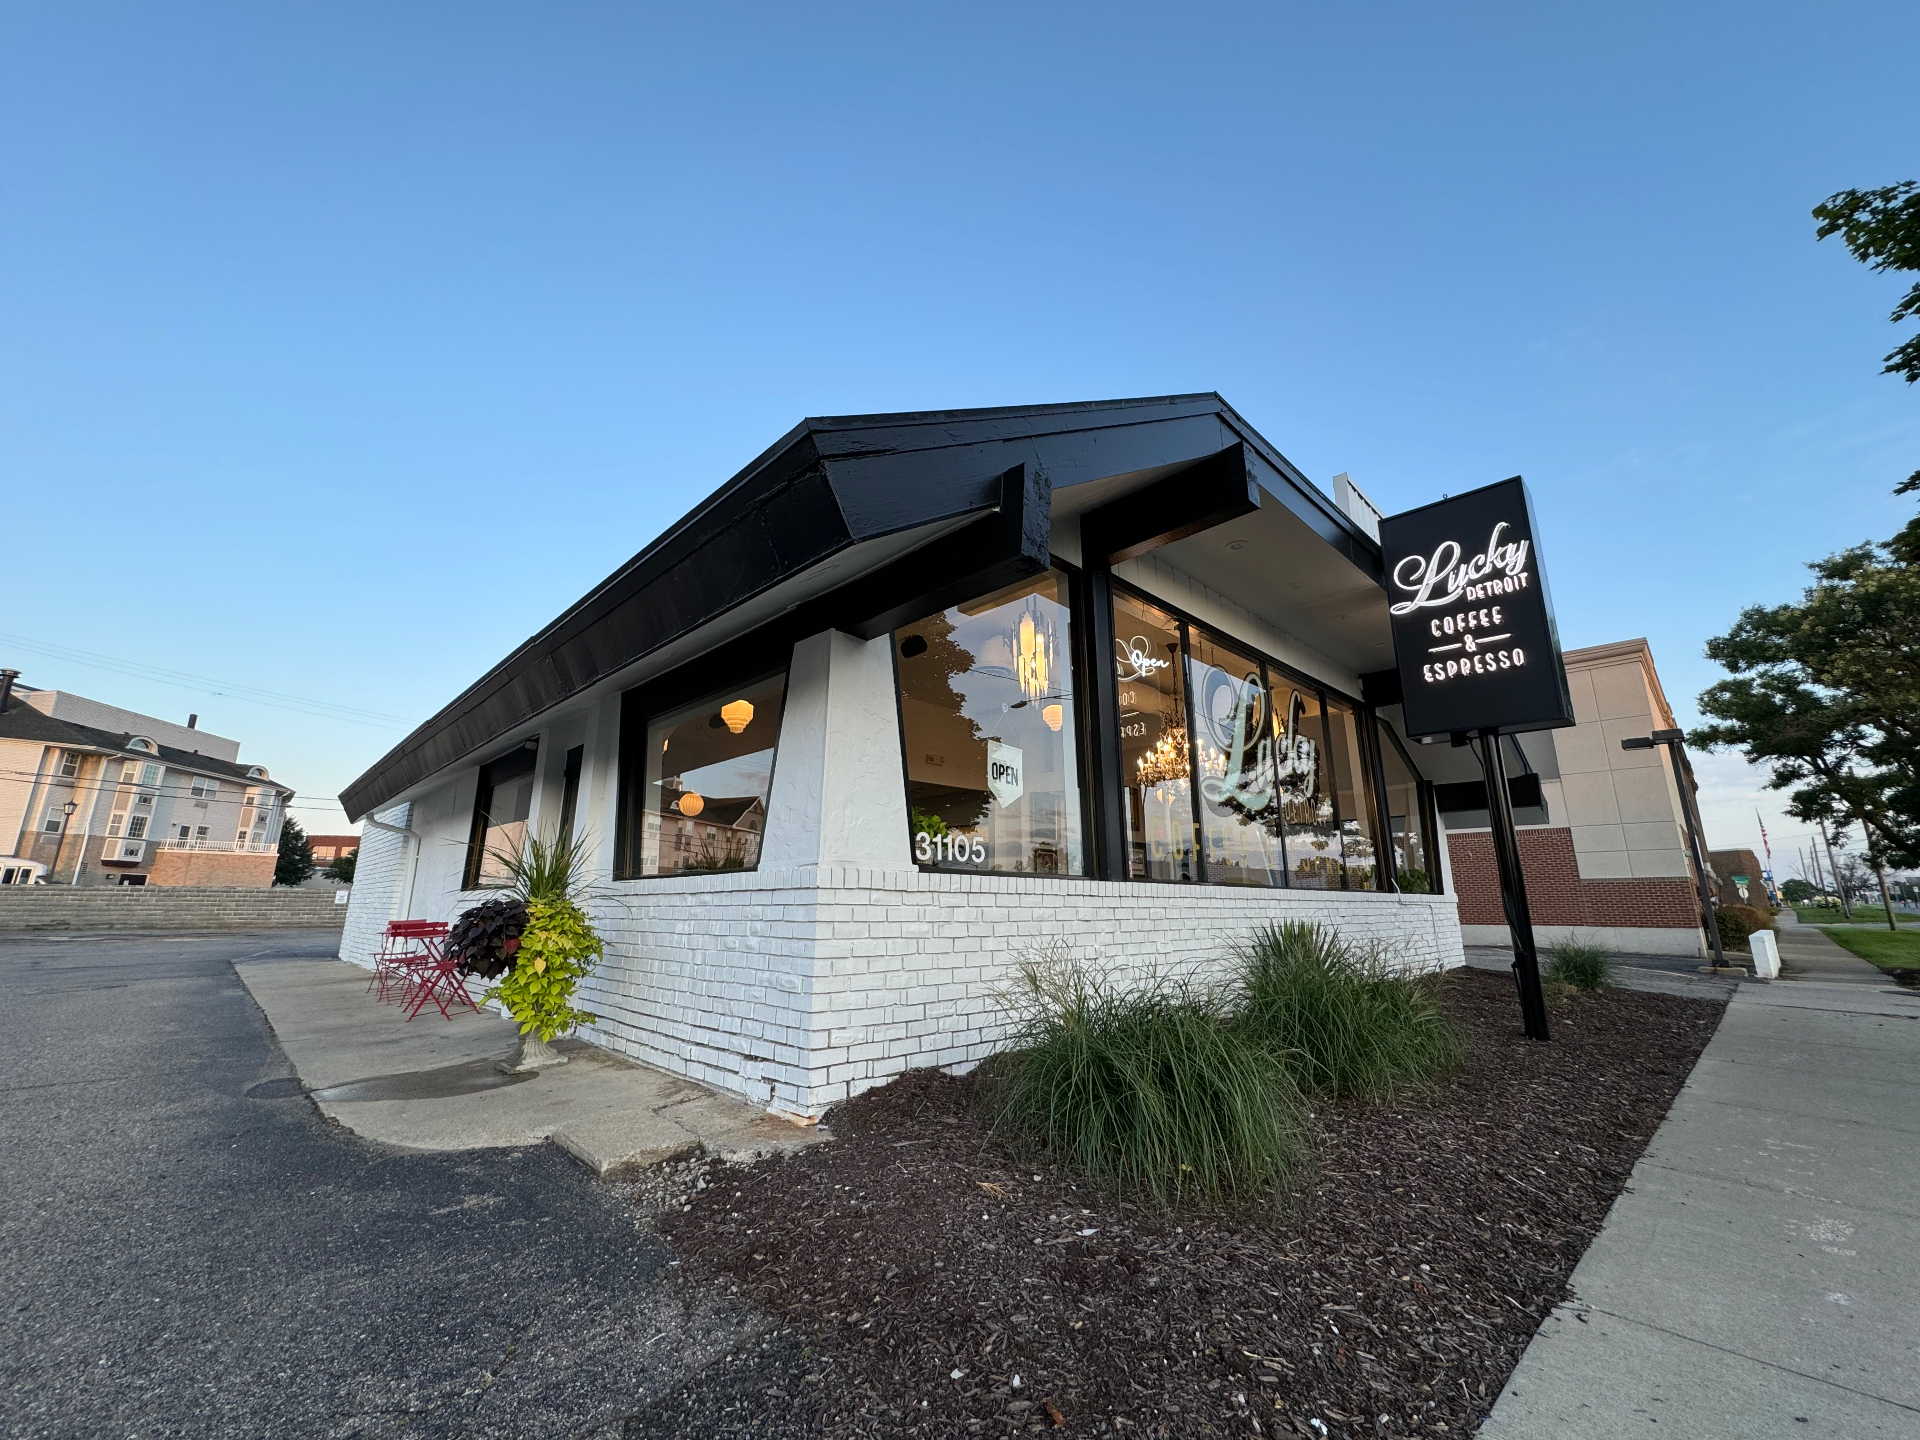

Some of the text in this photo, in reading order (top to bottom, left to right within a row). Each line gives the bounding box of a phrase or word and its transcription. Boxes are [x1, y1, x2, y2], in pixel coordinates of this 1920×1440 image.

[1390, 522, 1530, 615] Lucky
[1467, 572, 1529, 602] DETROIT
[1431, 606, 1503, 637] COFFEE
[1463, 634, 1477, 653] &
[1131, 650, 1170, 677] Open
[1423, 648, 1526, 683] ESPRESSO
[1201, 664, 1317, 811] Lucky
[991, 762, 1019, 787] OPEN
[915, 831, 986, 863] 31105
